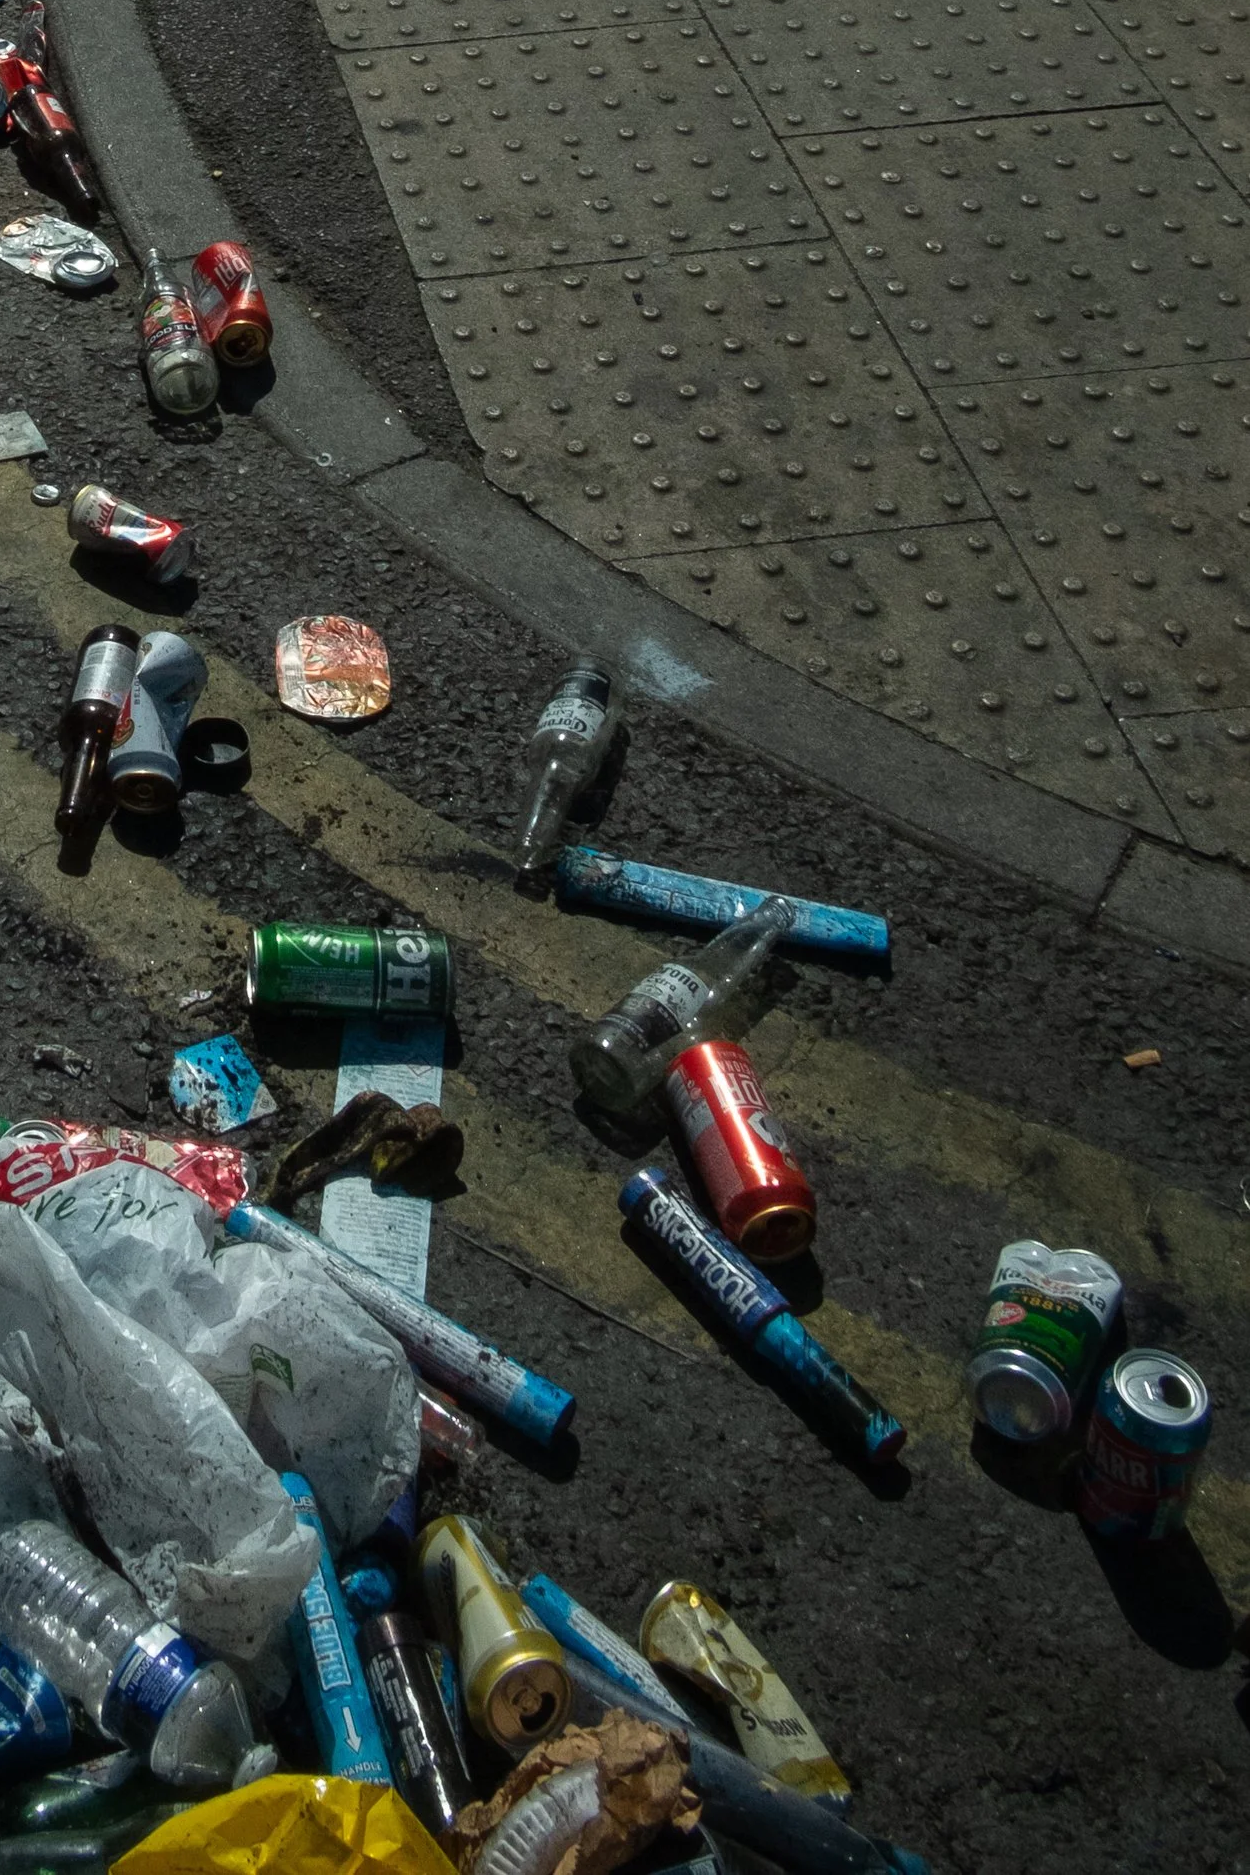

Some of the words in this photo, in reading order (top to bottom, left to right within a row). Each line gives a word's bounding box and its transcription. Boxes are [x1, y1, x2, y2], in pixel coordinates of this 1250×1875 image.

[647, 1195, 759, 1322] HOOLIGANS
[1021, 1296, 1063, 1314] 1881
[339, 1761, 383, 1779] HANDLE
